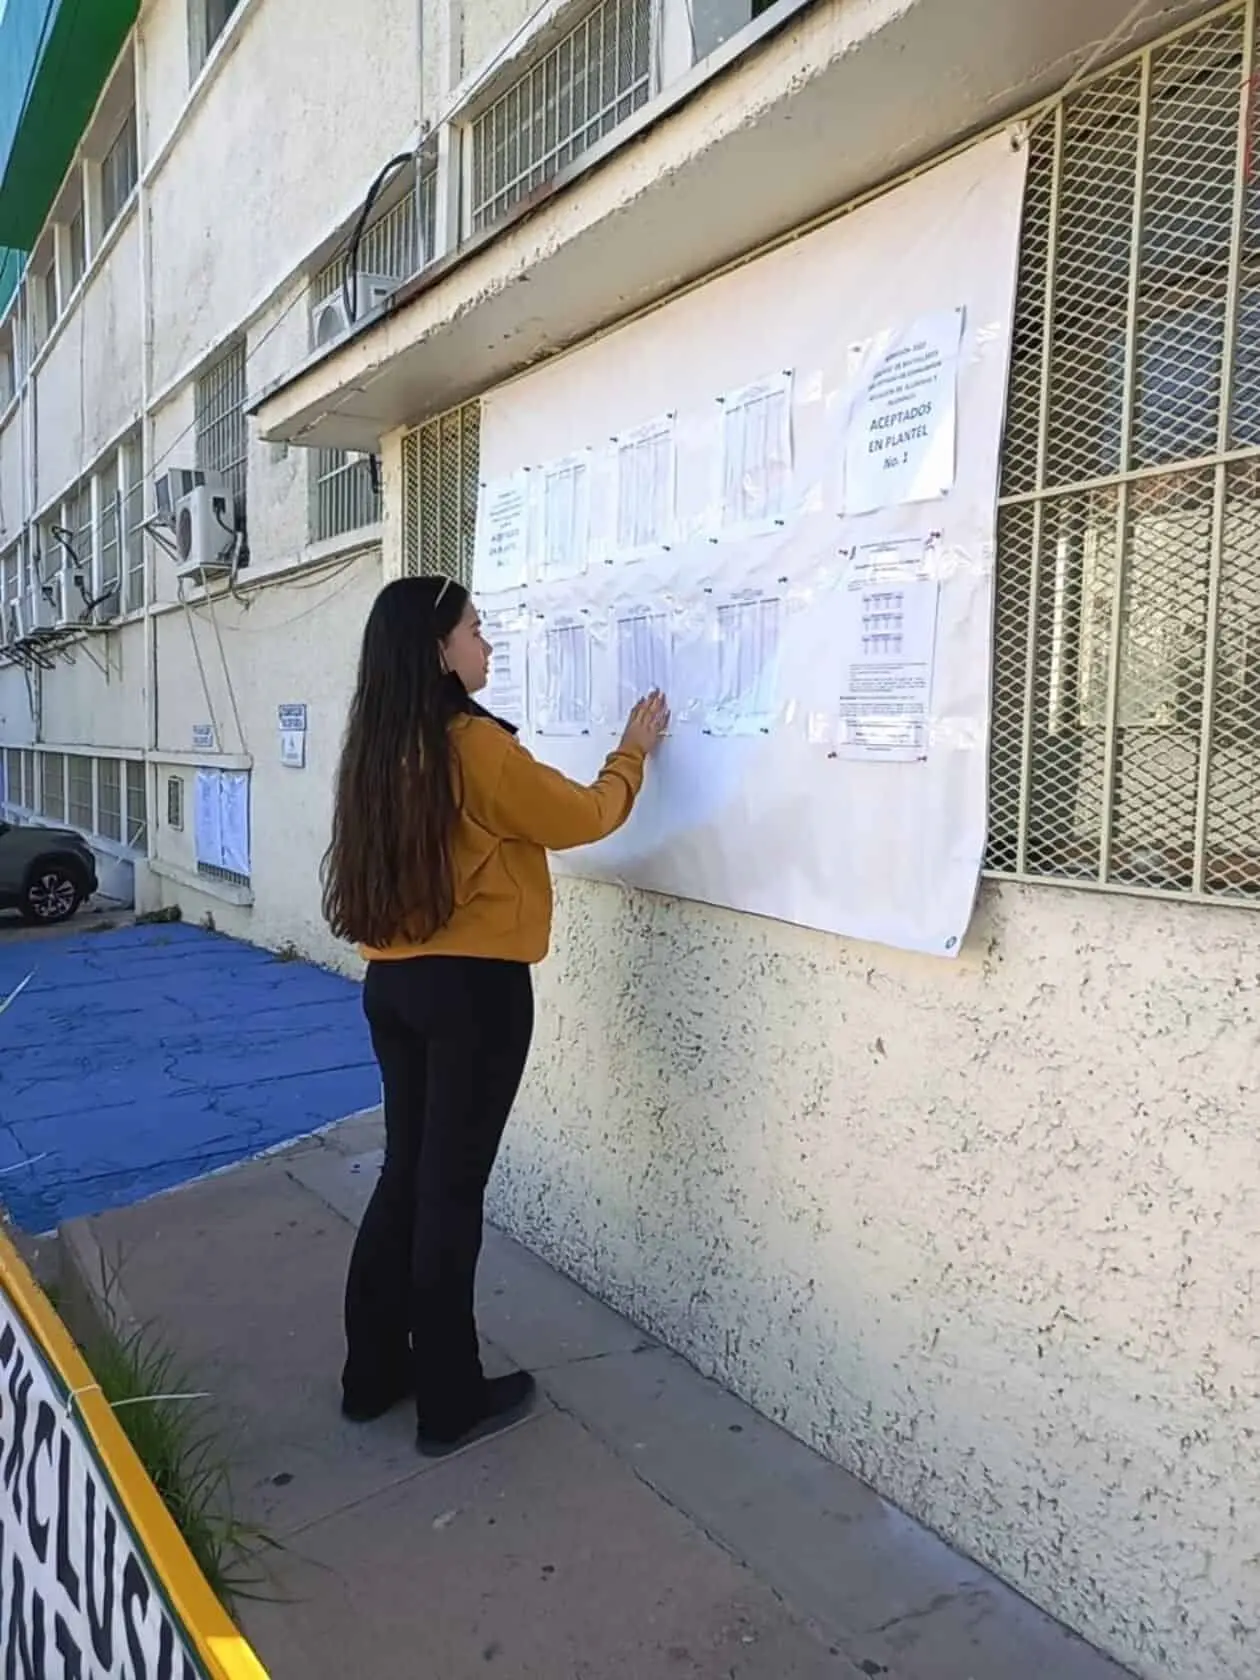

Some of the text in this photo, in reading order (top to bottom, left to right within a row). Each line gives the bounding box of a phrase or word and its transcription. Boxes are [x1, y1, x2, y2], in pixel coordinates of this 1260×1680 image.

[869, 401, 931, 430] ACEPTADOS
[868, 423, 929, 453] EN PLANTEL
